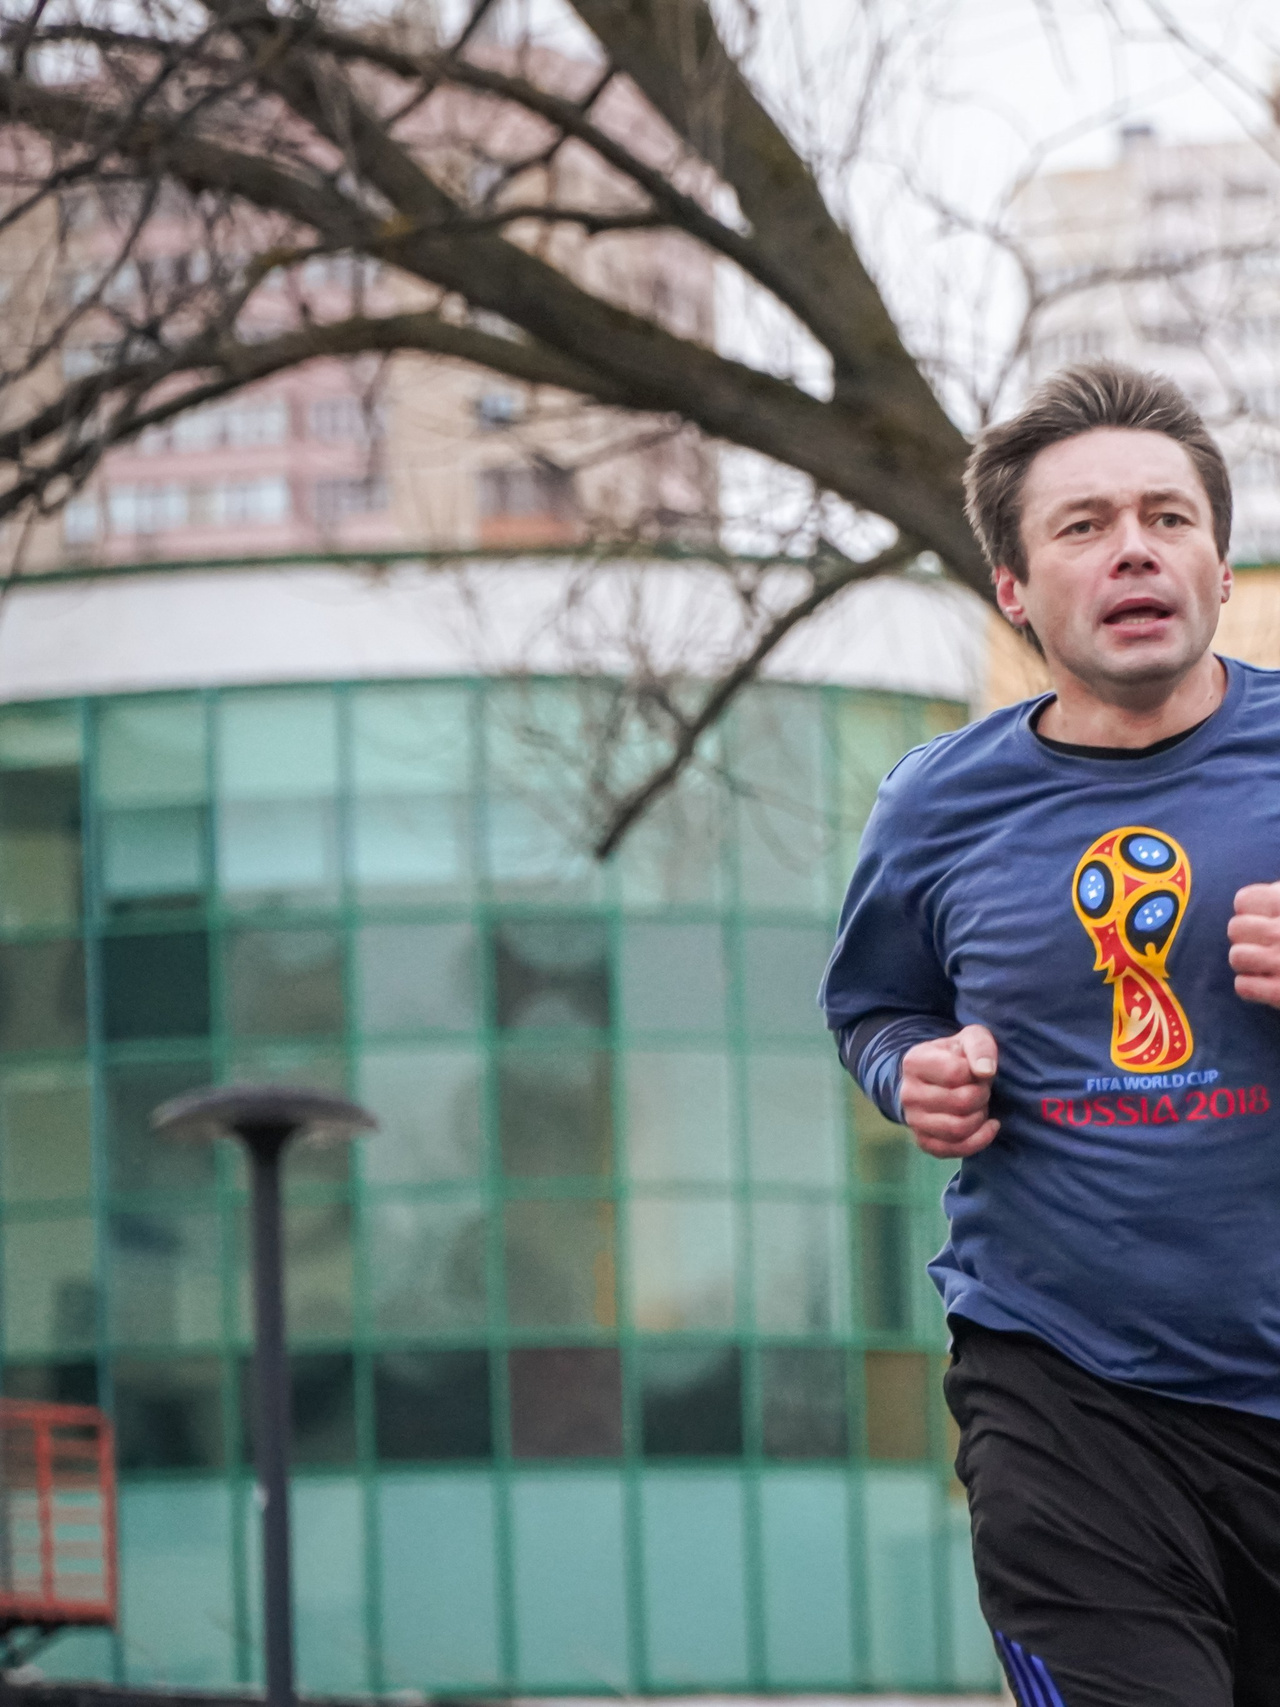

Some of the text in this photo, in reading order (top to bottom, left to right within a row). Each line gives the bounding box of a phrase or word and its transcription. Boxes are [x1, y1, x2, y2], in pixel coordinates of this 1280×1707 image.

[1086, 1070, 1219, 1092] FIFA WORLD CUP
[1041, 1084, 1270, 1127] RUSSIA 2018
